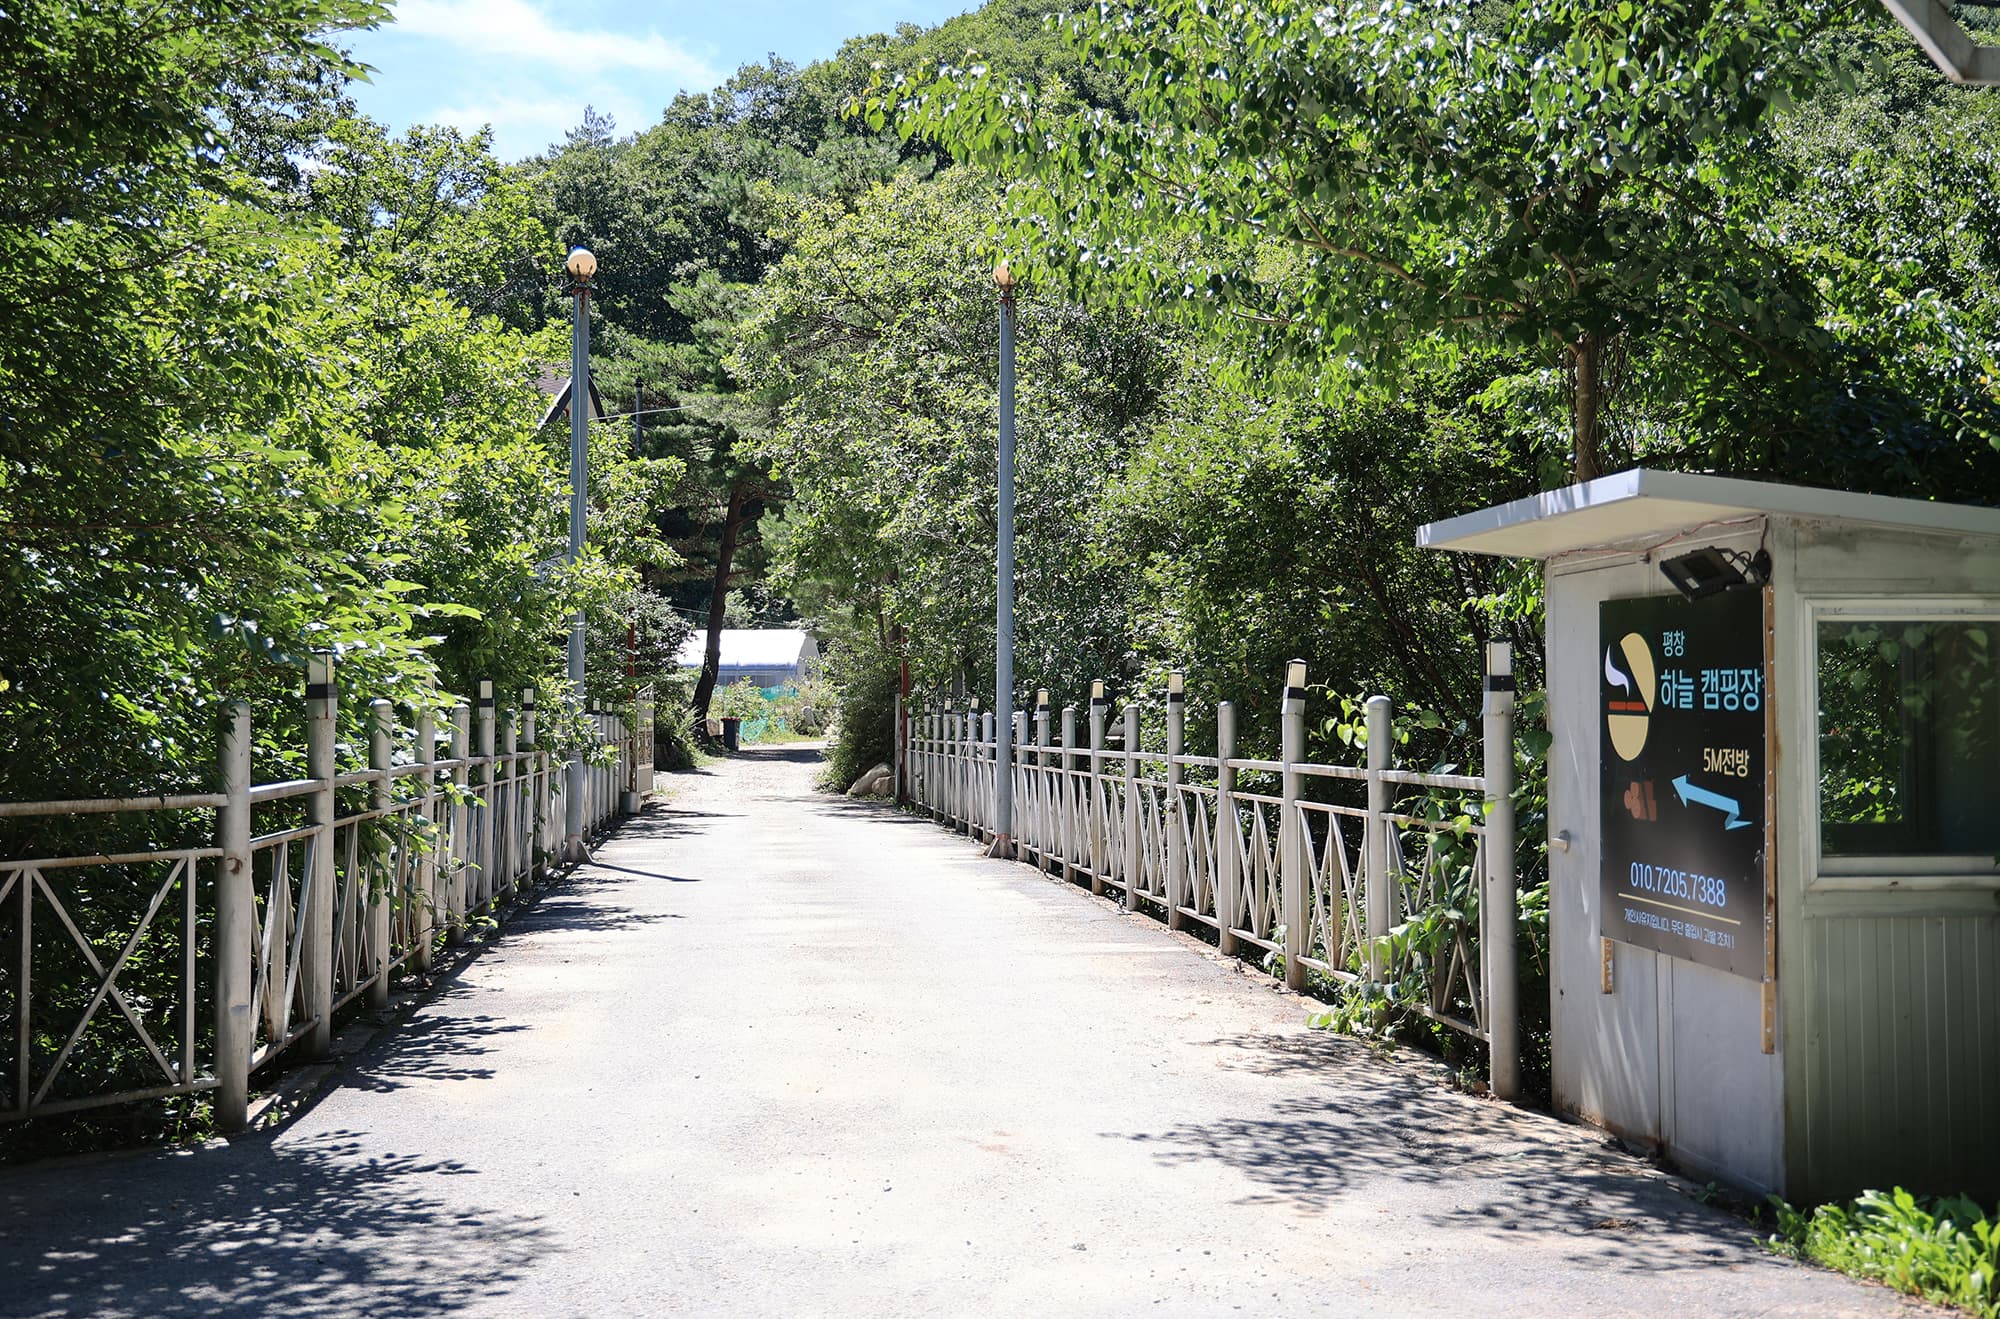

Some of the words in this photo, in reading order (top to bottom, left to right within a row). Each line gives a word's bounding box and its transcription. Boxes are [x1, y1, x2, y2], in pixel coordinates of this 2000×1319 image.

[1662, 630, 1685, 657] 평창
[1660, 669, 1695, 709] 하늘
[1700, 668, 1761, 711] 캠핑장
[1703, 748, 1750, 778] 5M전방
[1630, 861, 1726, 907] 010.7205.7388
